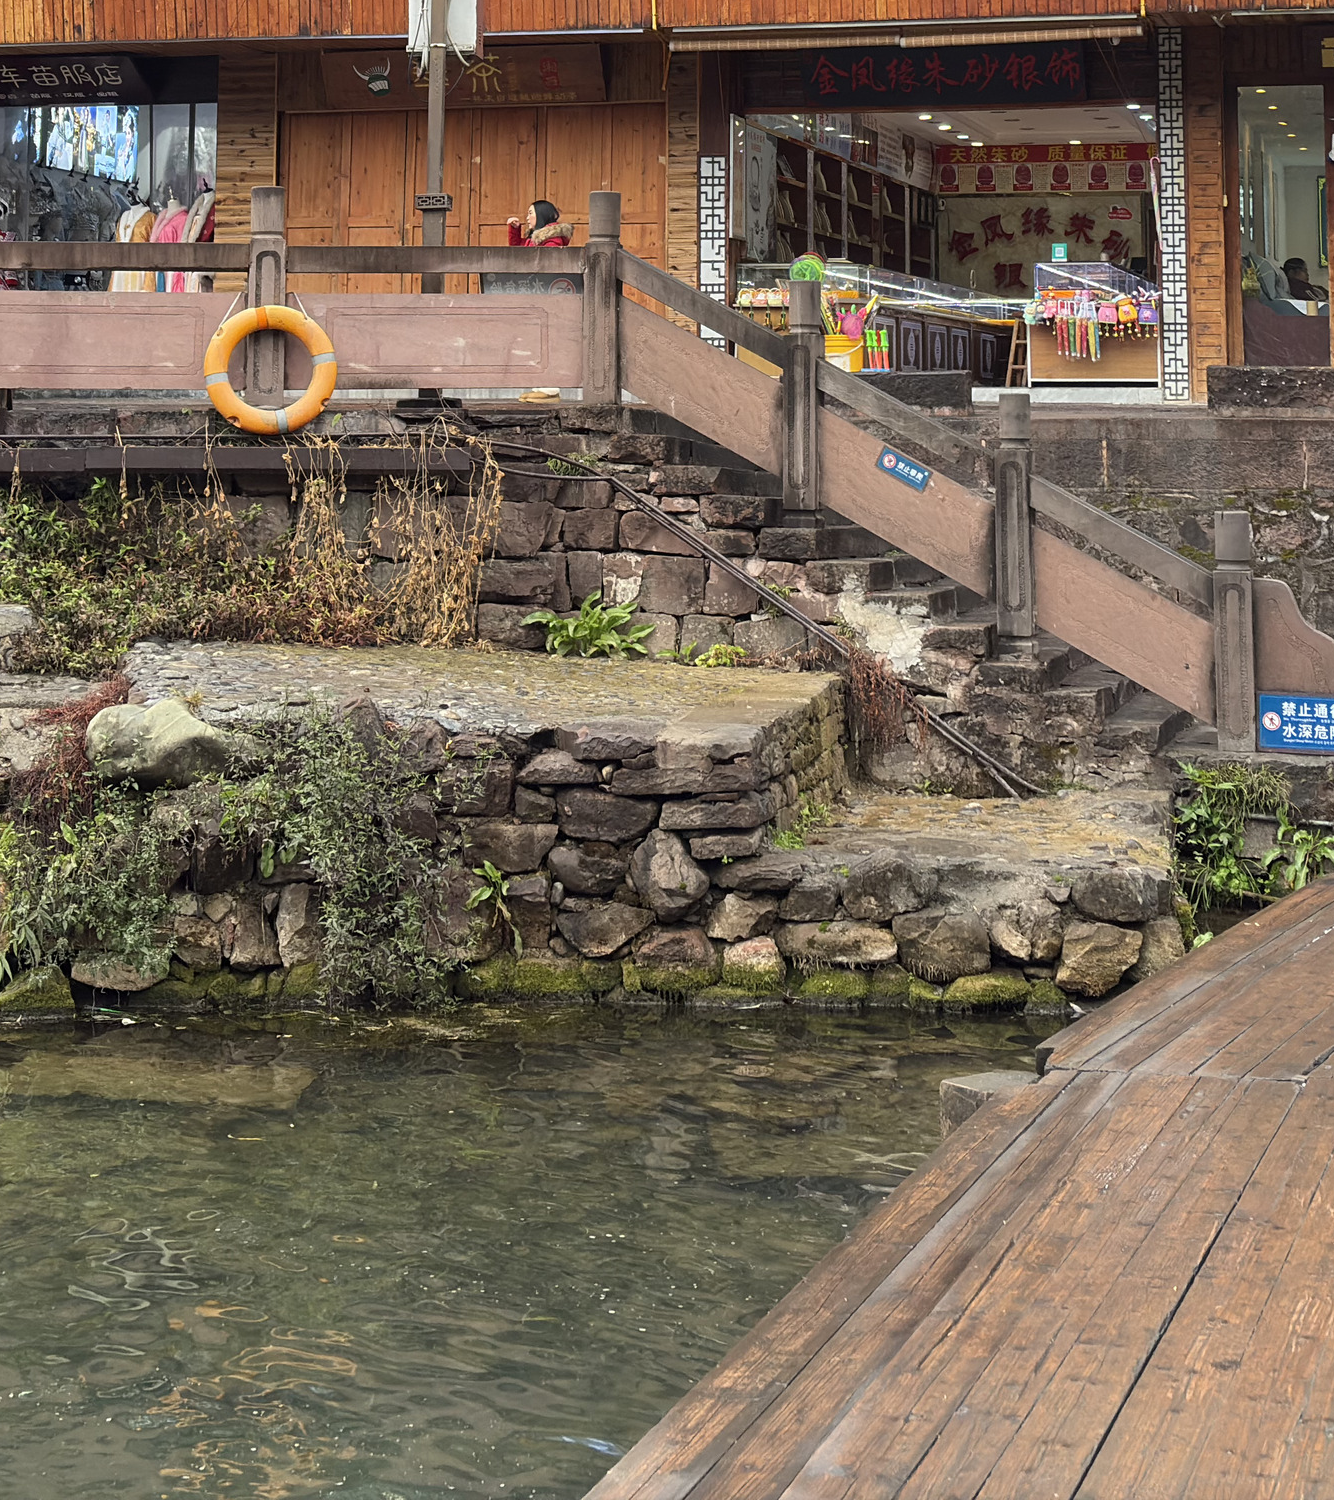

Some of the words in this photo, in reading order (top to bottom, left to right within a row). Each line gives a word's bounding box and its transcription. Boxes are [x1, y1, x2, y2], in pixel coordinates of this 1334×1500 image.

[950, 146, 1028, 162] 天然朱砂
[1048, 145, 1128, 161] 质量保证
